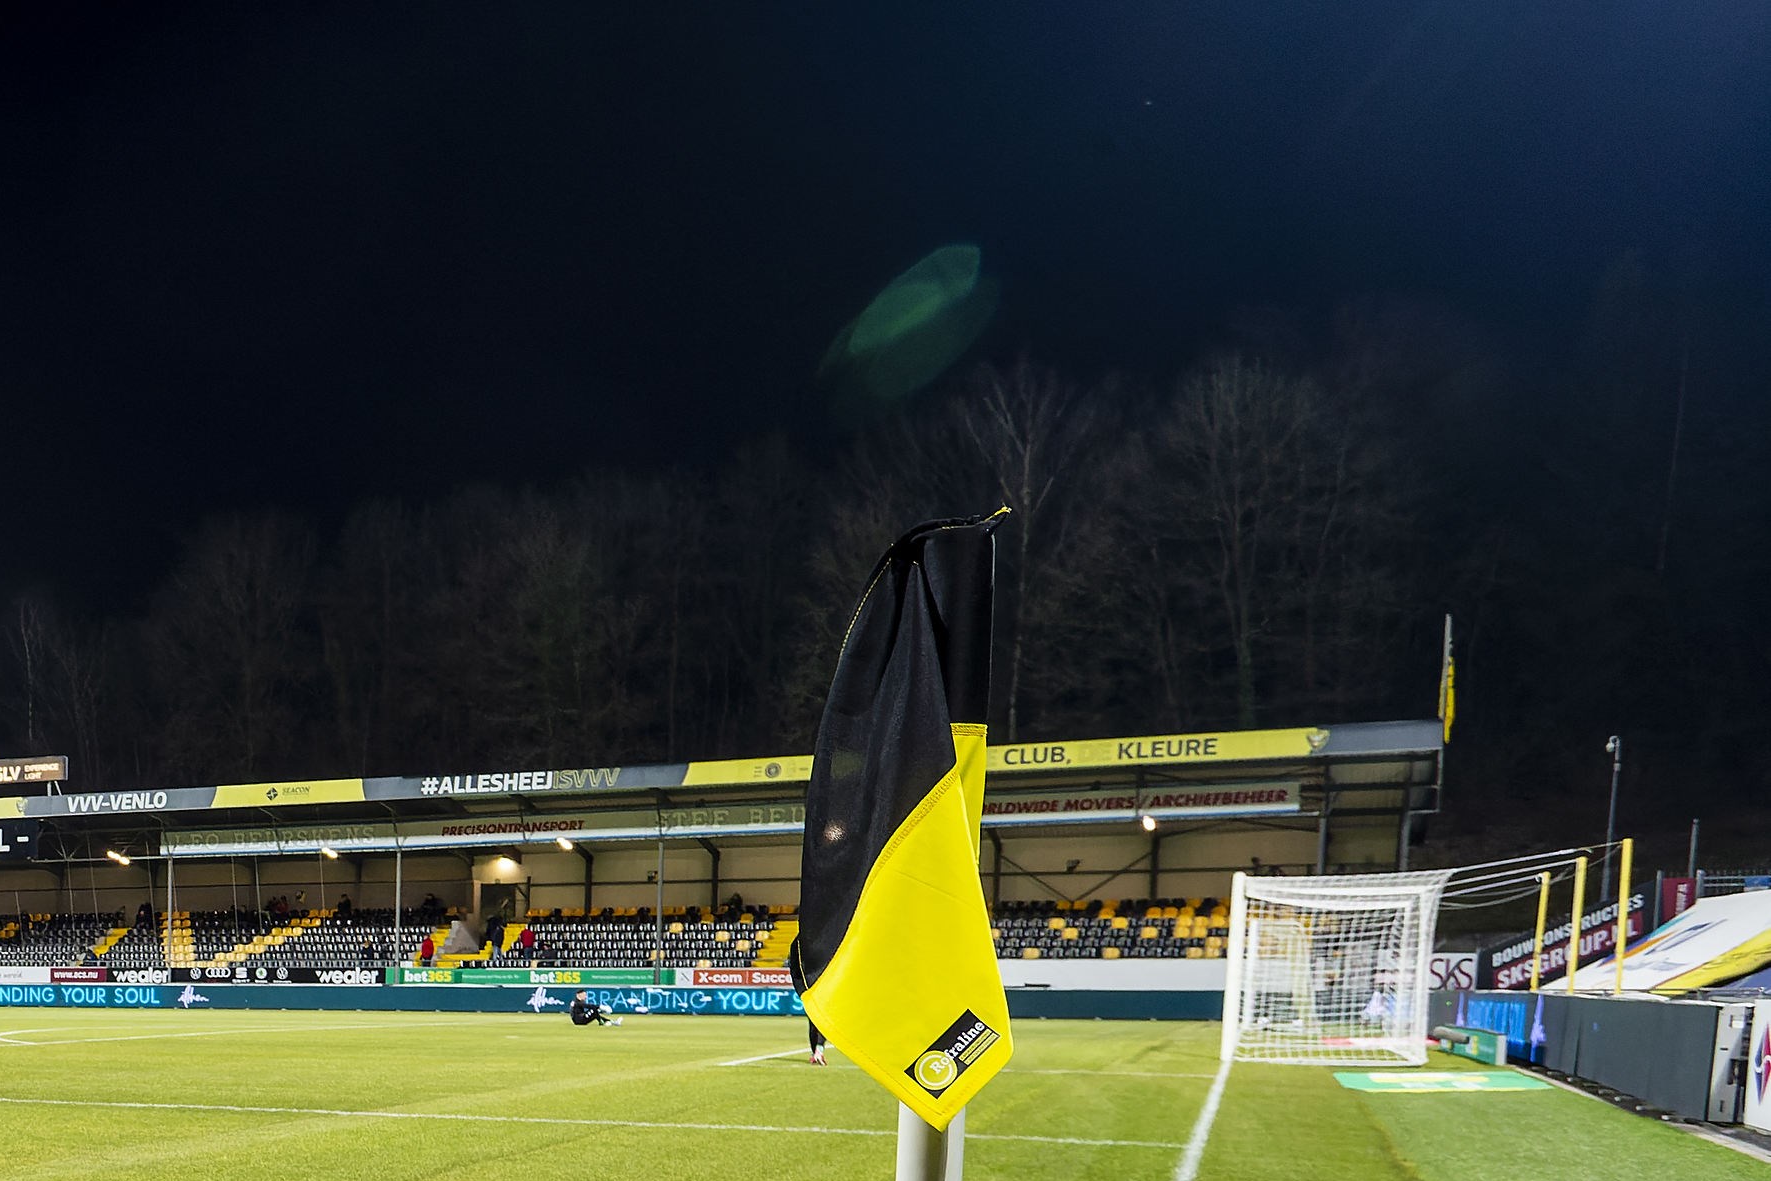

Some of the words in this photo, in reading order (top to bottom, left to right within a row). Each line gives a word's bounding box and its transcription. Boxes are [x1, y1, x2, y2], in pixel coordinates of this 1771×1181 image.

[1004, 746, 1071, 765] CLUB,
[1118, 738, 1218, 760] KLEURE
[67, 792, 167, 813] VVV-VENLO
[983, 800, 1058, 815] RLDWIDE
[1063, 796, 1135, 812] MOVERS
[442, 820, 585, 837] PRECISIONTRANSPORT
[113, 967, 169, 983] wealer
[315, 967, 378, 984] wealer
[404, 970, 452, 982] bet365
[530, 970, 580, 984] bet365
[1429, 958, 1473, 990] SKS
[61, 987, 106, 1004] YOUR
[114, 987, 160, 1004] SOUL
[719, 992, 780, 1010] YOUR
[929, 1021, 986, 1074] Rofraline
